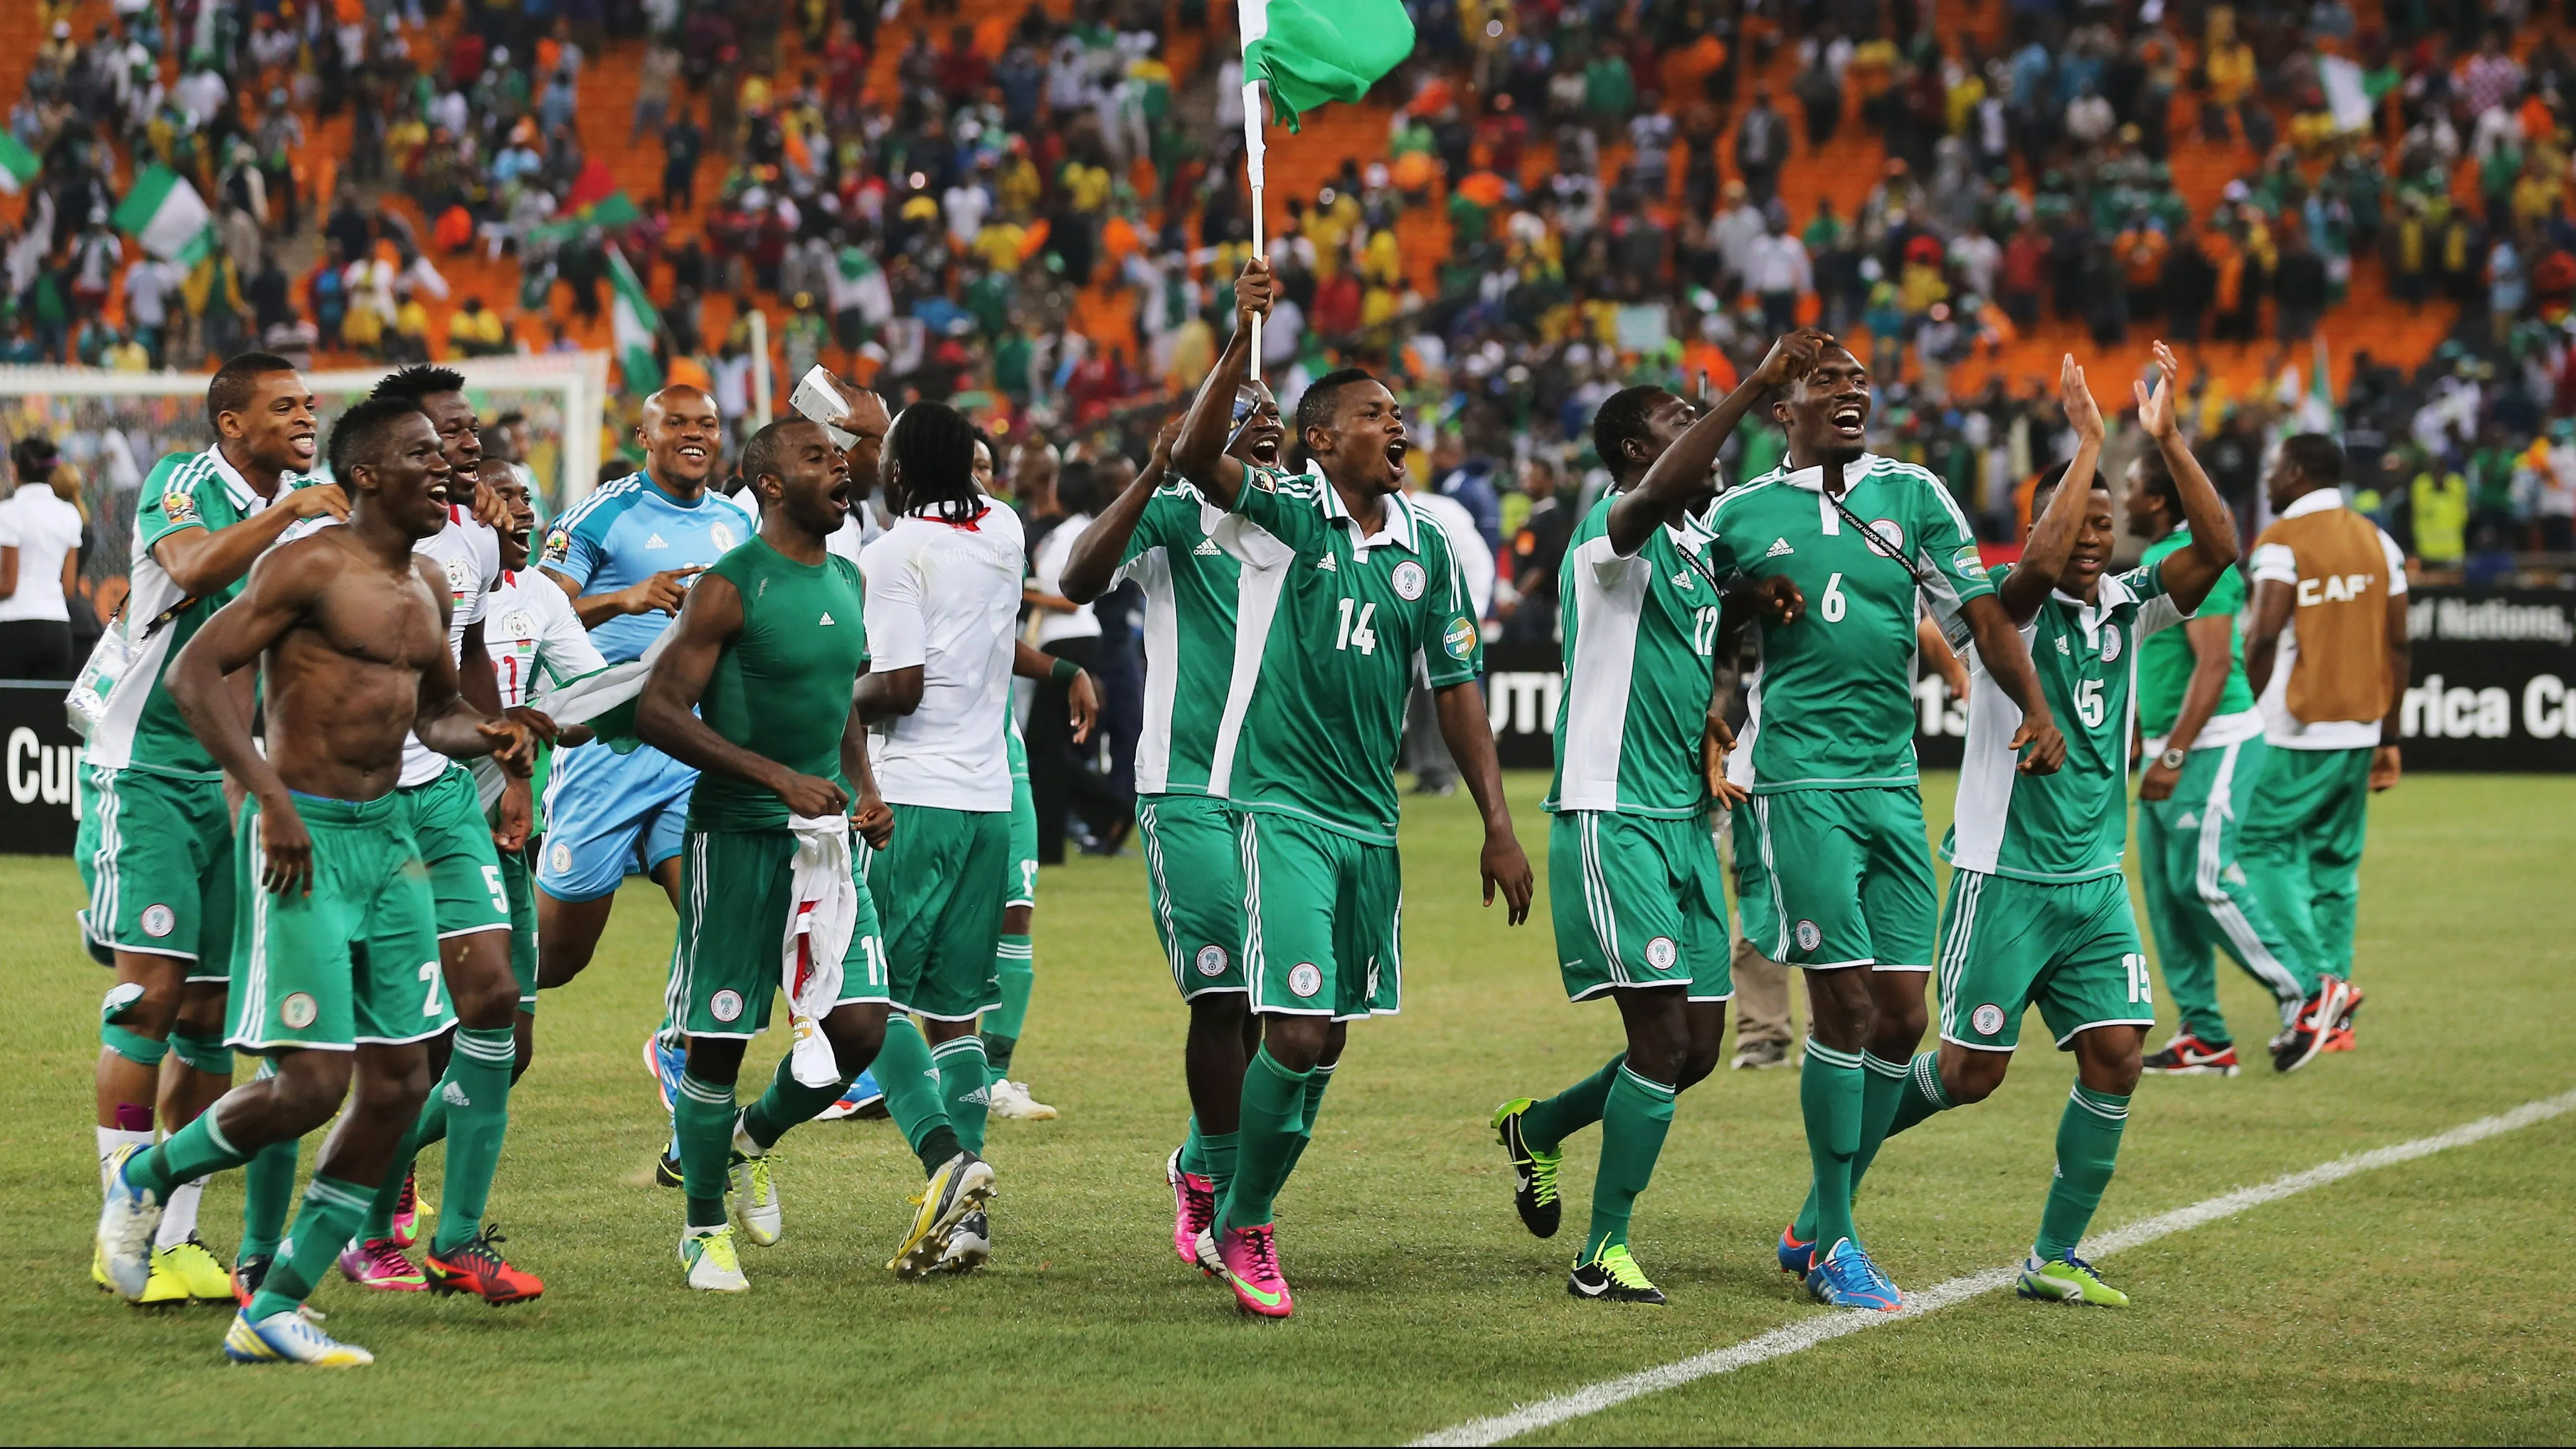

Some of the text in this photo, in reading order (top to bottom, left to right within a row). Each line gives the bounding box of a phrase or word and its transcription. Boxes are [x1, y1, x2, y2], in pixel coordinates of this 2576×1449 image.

[1845, 513, 1864, 529] AFRICA
[1862, 527, 1880, 543] SOUTH
[1766, 547, 1794, 558] adidas
[1671, 577, 1695, 590] adidas
[1822, 572, 1846, 623] 6
[2297, 574, 2366, 607] CAF
[1336, 597, 1376, 655] 14
[1694, 606, 1718, 655] 12
[2437, 597, 2574, 646] Nations,
[490, 655, 517, 704] 1
[481, 866, 508, 914] 5
[418, 958, 443, 1018] 2
[2122, 953, 2153, 1004] 15
[959, 1093, 991, 1107] adida
